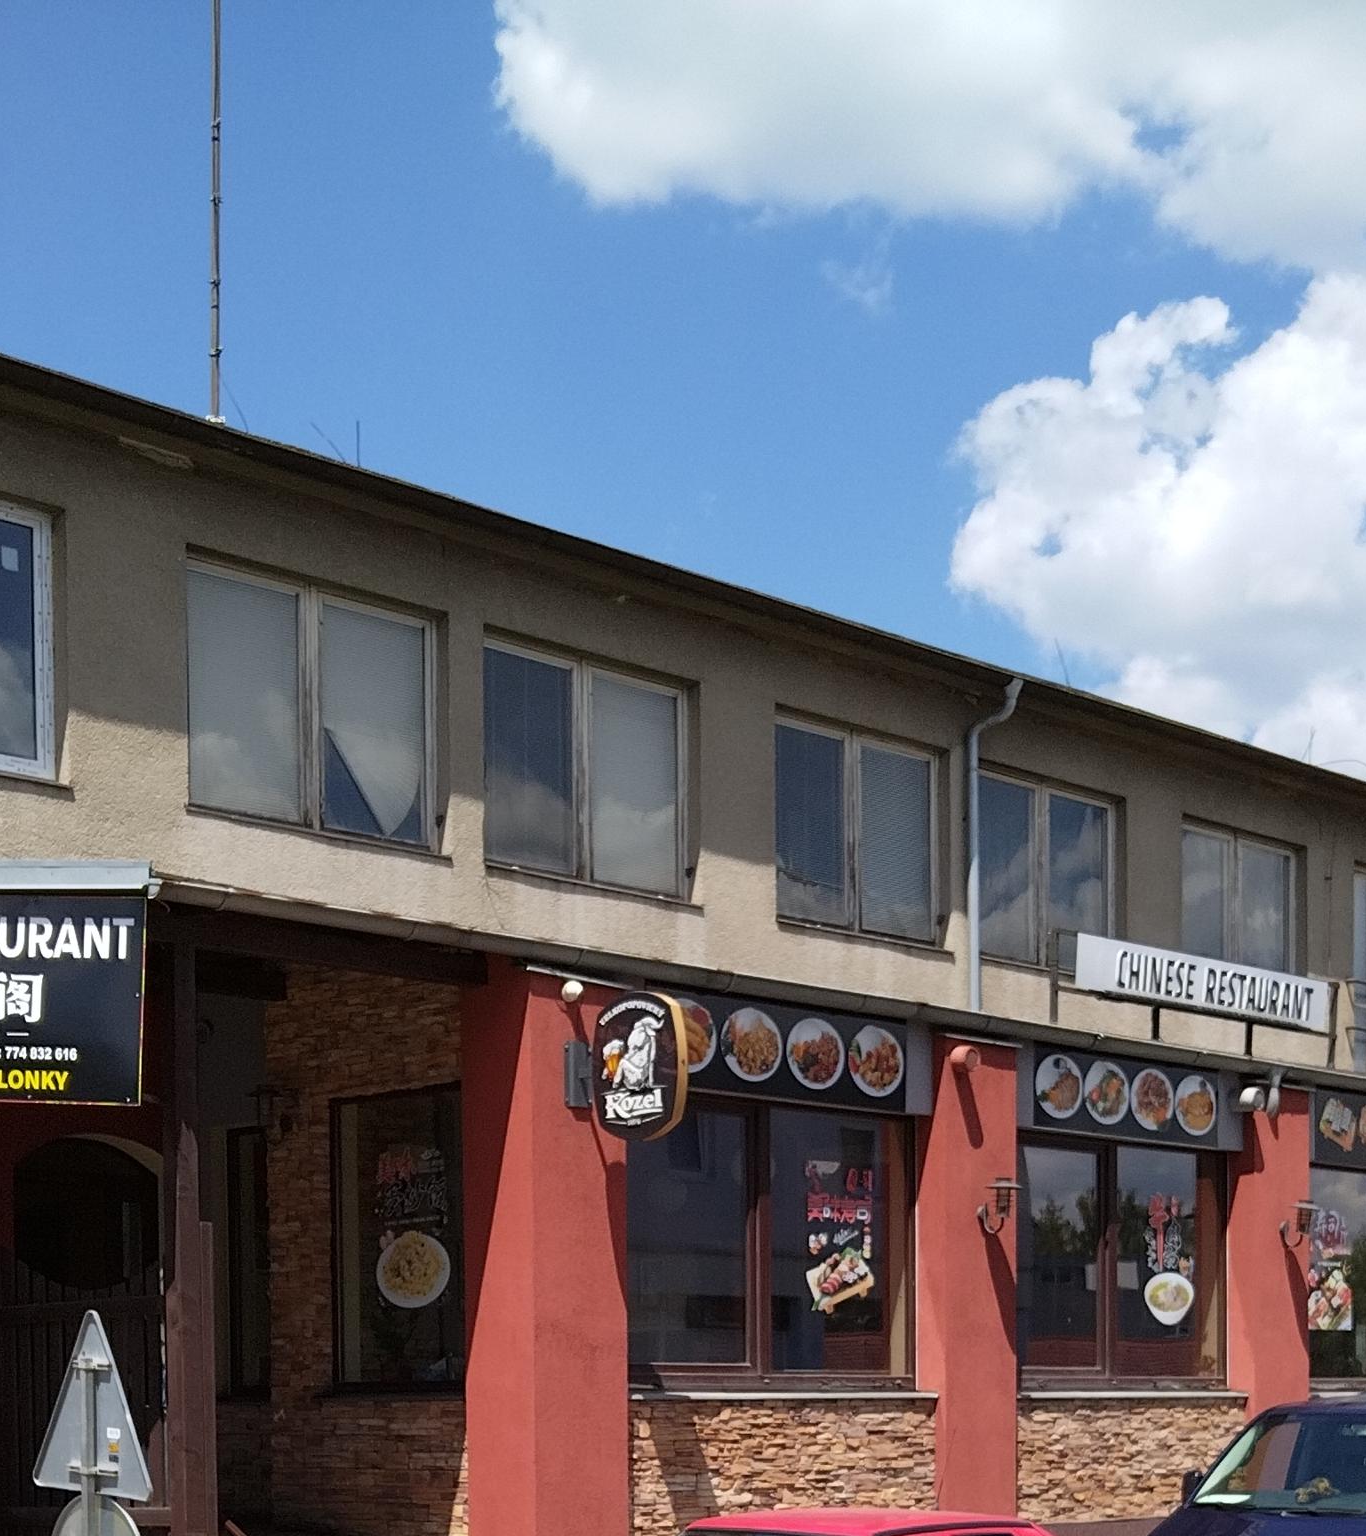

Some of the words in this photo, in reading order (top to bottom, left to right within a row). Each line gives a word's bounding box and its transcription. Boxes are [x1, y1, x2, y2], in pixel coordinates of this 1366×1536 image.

[1115, 949, 1197, 1000] CHINESE
[1203, 966, 1314, 1021] RESTAURANT
[5, 1046, 27, 1060] 774
[55, 1047, 78, 1061] 616
[604, 1088, 663, 1119] Kozel
